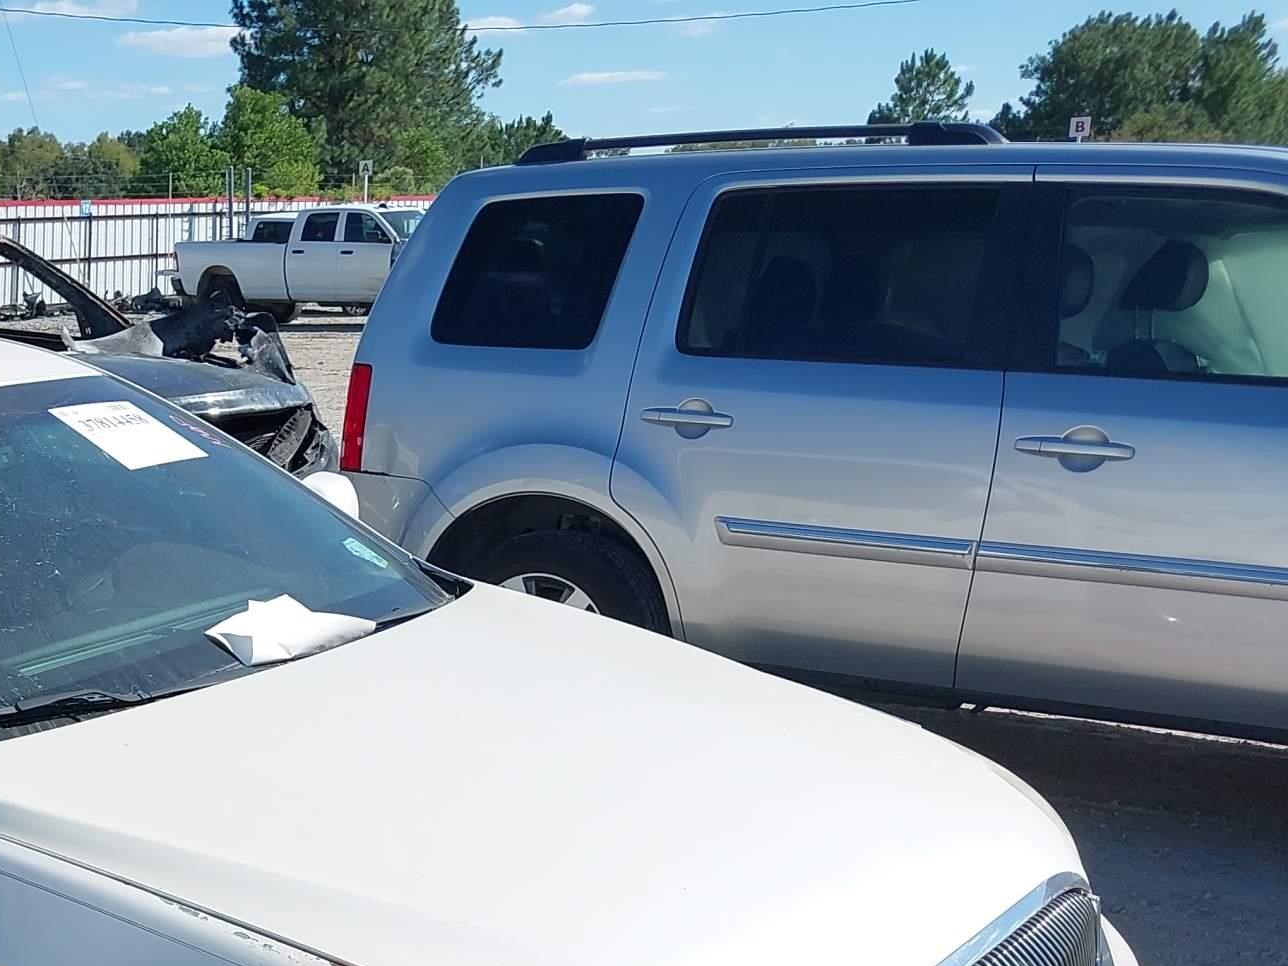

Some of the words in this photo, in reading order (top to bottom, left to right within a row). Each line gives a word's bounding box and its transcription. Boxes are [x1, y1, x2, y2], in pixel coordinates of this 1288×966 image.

[1074, 120, 1086, 133] B
[361, 162, 370, 173] A
[77, 412, 150, 432] 37814458
